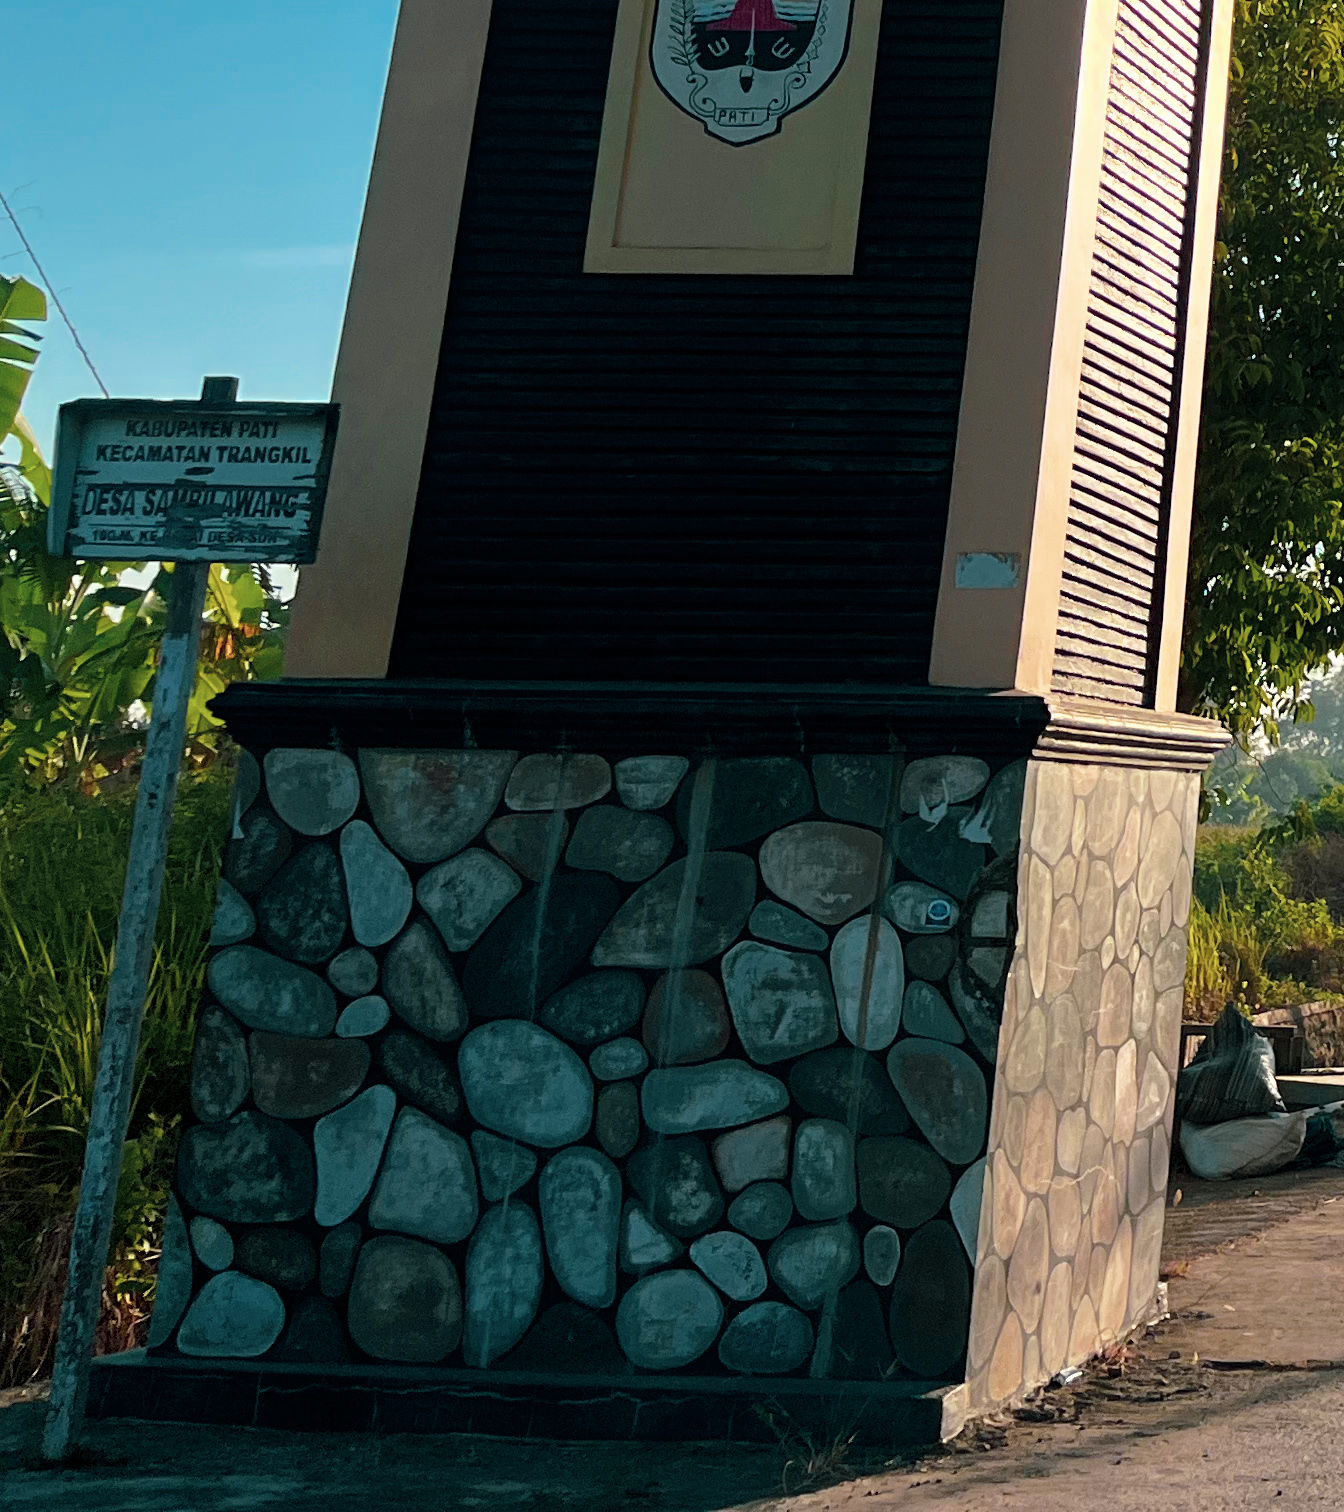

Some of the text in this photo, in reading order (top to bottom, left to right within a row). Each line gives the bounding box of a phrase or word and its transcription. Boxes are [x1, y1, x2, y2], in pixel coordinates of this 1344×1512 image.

[717, 110, 755, 124] PATI
[125, 420, 279, 439] KABUPATEN PATI
[96, 444, 312, 465] KECAMATAN TRANGKIL
[82, 488, 135, 516] DESA
